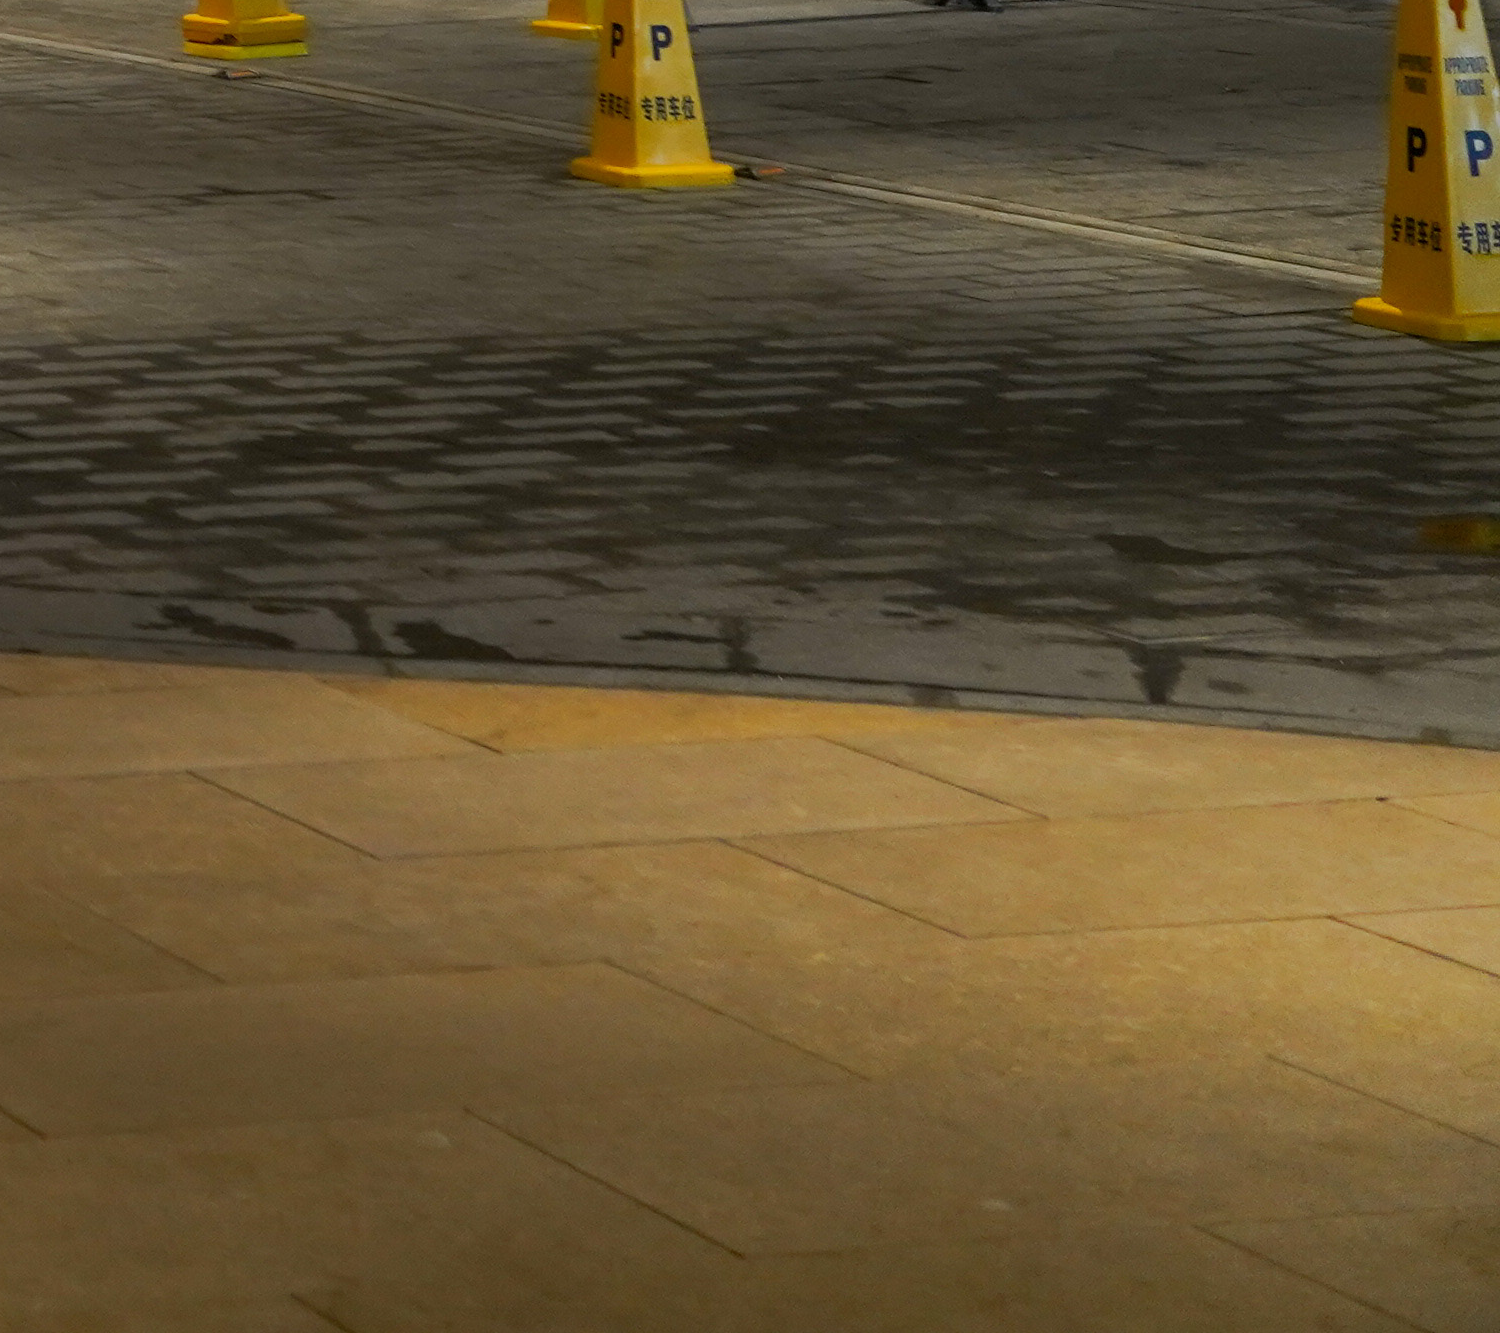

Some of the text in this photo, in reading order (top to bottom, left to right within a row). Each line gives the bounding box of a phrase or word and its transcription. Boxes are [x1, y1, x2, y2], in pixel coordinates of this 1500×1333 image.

[611, 22, 625, 59] P
[650, 24, 672, 61] P
[641, 95, 697, 122] 专用车位
[1407, 126, 1427, 173] P
[1464, 129, 1494, 177] P
[1390, 214, 1443, 253] 专用车位
